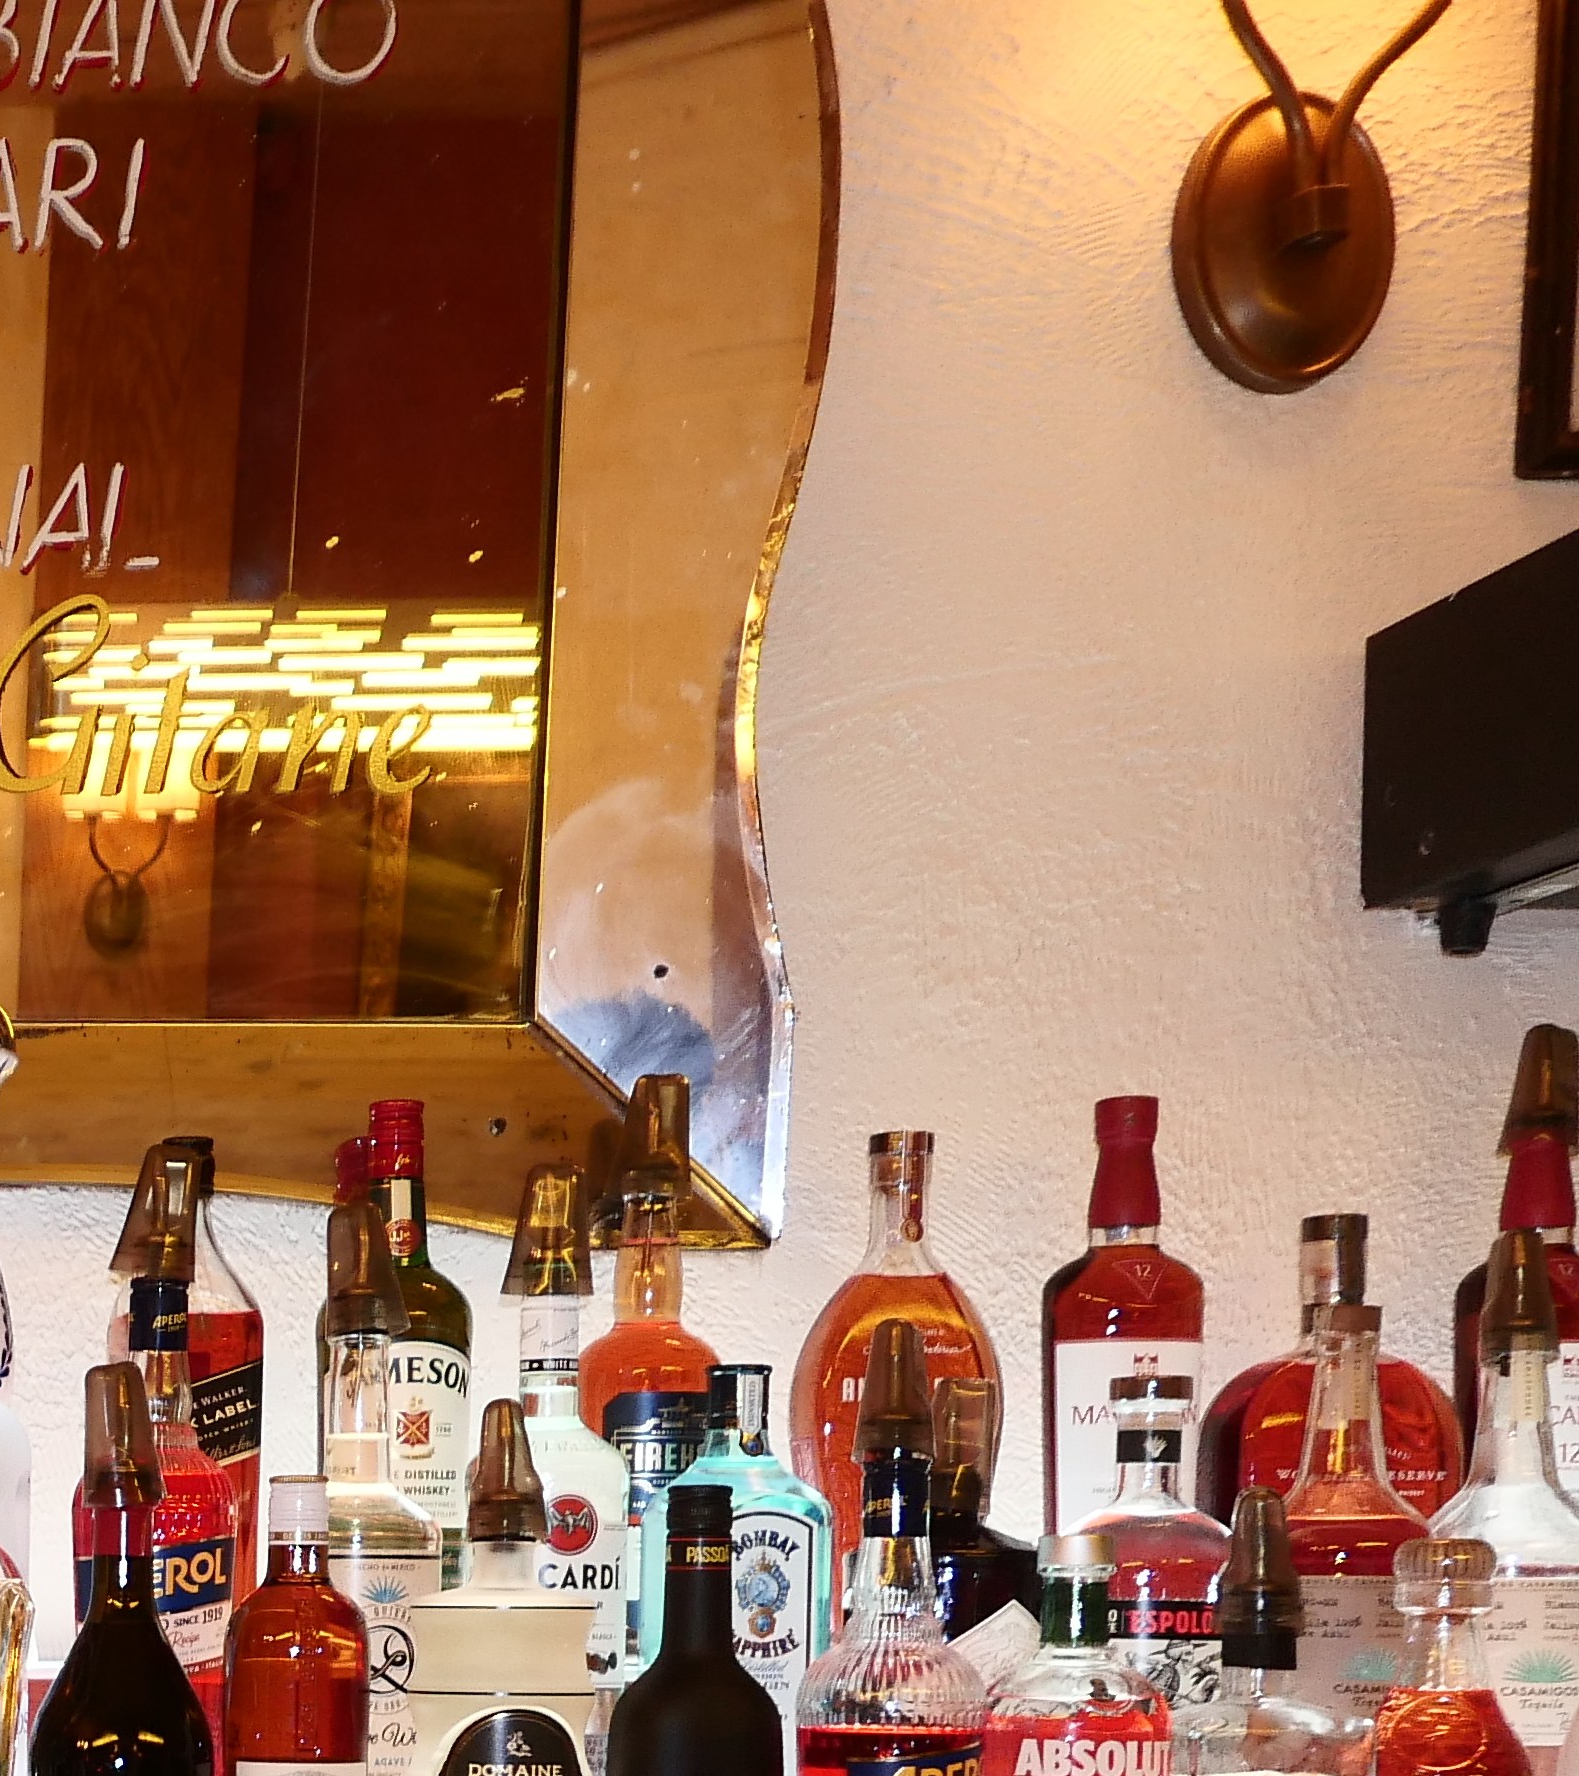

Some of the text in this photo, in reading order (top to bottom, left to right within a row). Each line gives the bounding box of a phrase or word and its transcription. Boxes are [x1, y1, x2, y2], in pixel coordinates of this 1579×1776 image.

[200, 1385, 246, 1406] WALKER
[202, 1398, 257, 1426] LABEL
[538, 1556, 621, 1591] CARDÍ
[173, 1607, 224, 1628] SINCE 1919
